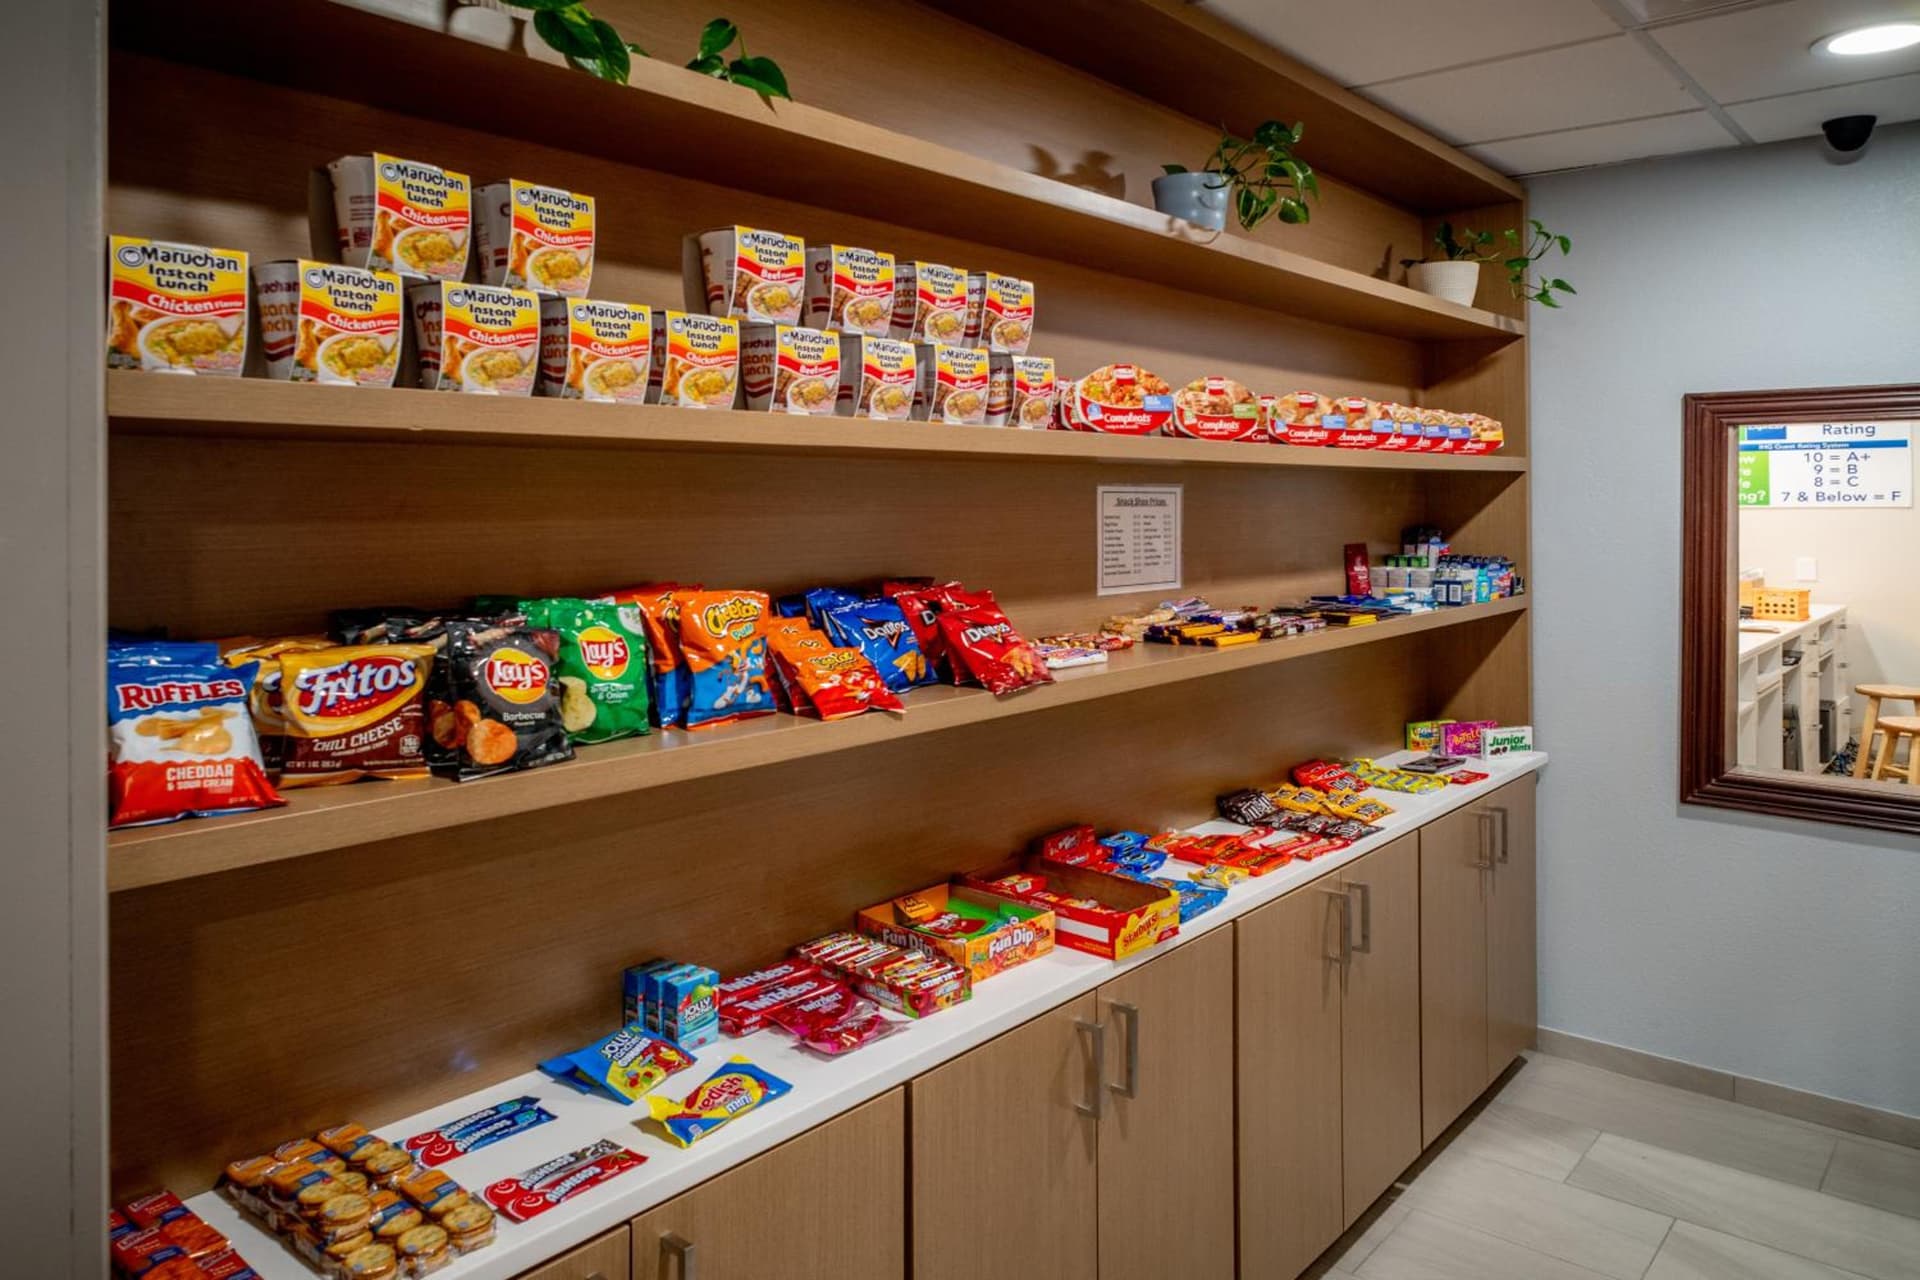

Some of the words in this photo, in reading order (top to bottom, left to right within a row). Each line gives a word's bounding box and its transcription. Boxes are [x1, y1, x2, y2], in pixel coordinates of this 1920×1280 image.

[396, 165, 463, 191] Maruchan
[402, 181, 447, 199] Instant
[407, 192, 444, 208] Lunch
[529, 189, 589, 212] Maruchan
[401, 207, 447, 225] Chicken
[534, 203, 574, 221] Instant
[539, 215, 571, 229] Lunch
[534, 228, 574, 244] Chicken
[750, 233, 800, 251] Maruchan
[140, 246, 238, 271] Maruchan
[755, 246, 788, 259] Instant
[758, 254, 785, 265] Lunch
[846, 252, 890, 267] Maruchan
[148, 264, 216, 282] Instant
[760, 268, 781, 280] Beef
[849, 263, 880, 274] Instant
[853, 271, 877, 281] Lunch
[156, 276, 209, 292] Lunch
[322, 269, 395, 293] Maruchan
[328, 285, 378, 303] Instant
[464, 289, 532, 308] Maruchan
[855, 285, 874, 296] Beef
[147, 293, 213, 314] Chicken
[333, 299, 373, 312] Lunch
[469, 304, 516, 317] Instant
[326, 313, 376, 329] Chicken
[586, 305, 645, 321] Maruchan
[475, 316, 512, 327] Lunch
[591, 318, 631, 331] Instant
[683, 317, 734, 334] Maruchan
[468, 329, 516, 344] Chicken
[596, 328, 628, 339] Lunch
[687, 330, 722, 342] Instant
[790, 331, 835, 345] Maruchan
[590, 341, 631, 355] Chicken
[690, 339, 718, 350] Lunch
[685, 352, 721, 364] Chicken
[797, 352, 822, 361] Lunch
[1822, 424, 1876, 439] Rating
[1804, 452, 1824, 463] 10
[1846, 451, 1871, 462] A+
[1813, 464, 1824, 475] 9
[1847, 464, 1858, 474] B
[1814, 477, 1824, 487] 8
[1847, 476, 1859, 487] C
[1781, 492, 1791, 502] 7
[1797, 491, 1808, 502] &
[1816, 491, 1867, 502] Below
[1892, 491, 1901, 501] F
[705, 597, 760, 636] Cheetos
[863, 621, 910, 640] Doritos
[582, 640, 626, 667] Lay's
[492, 659, 545, 689] Lay's
[295, 660, 416, 716] Fritos
[502, 711, 546, 722] Barbecue
[313, 738, 346, 752] CHILI
[350, 717, 404, 748] CHEESE
[1489, 734, 1525, 747] Junior
[1509, 743, 1532, 752] Mints
[166, 764, 234, 781] CHEDDAR
[883, 928, 907, 947] Fun
[908, 934, 933, 958] Dip
[989, 935, 1012, 959] Fun
[1013, 927, 1034, 947] Dip
[685, 996, 711, 1016] JOLLY
[601, 1030, 631, 1060] JOLLY
[726, 1092, 752, 1113] mini
